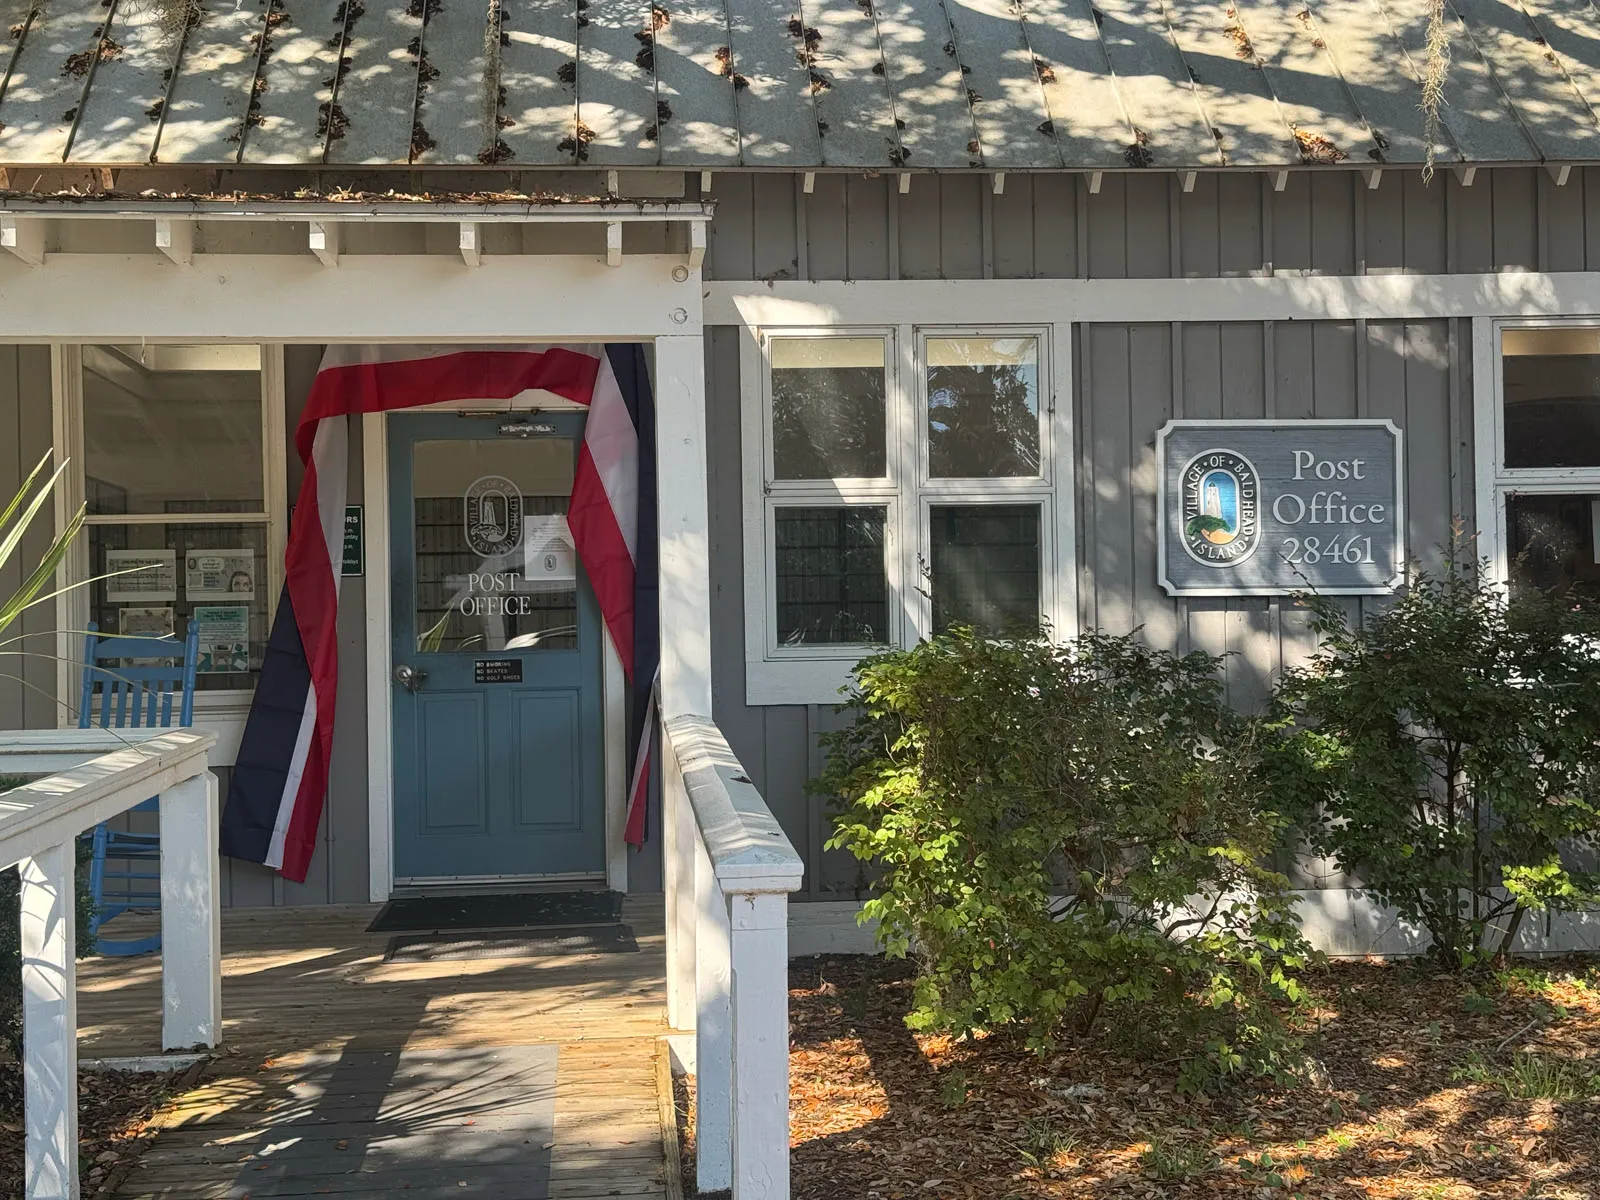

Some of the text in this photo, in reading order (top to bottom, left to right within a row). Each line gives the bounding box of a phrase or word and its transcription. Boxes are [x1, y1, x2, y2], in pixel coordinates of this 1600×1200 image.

[1291, 450, 1365, 481] Post
[1186, 463, 1205, 520] VILLAGE
[1209, 455, 1226, 468] OF
[1272, 491, 1385, 525] Office
[1191, 539, 1248, 559] ISLAND
[1282, 534, 1376, 565] 28461
[468, 572, 520, 592] POST
[460, 596, 531, 616] OFFICE
